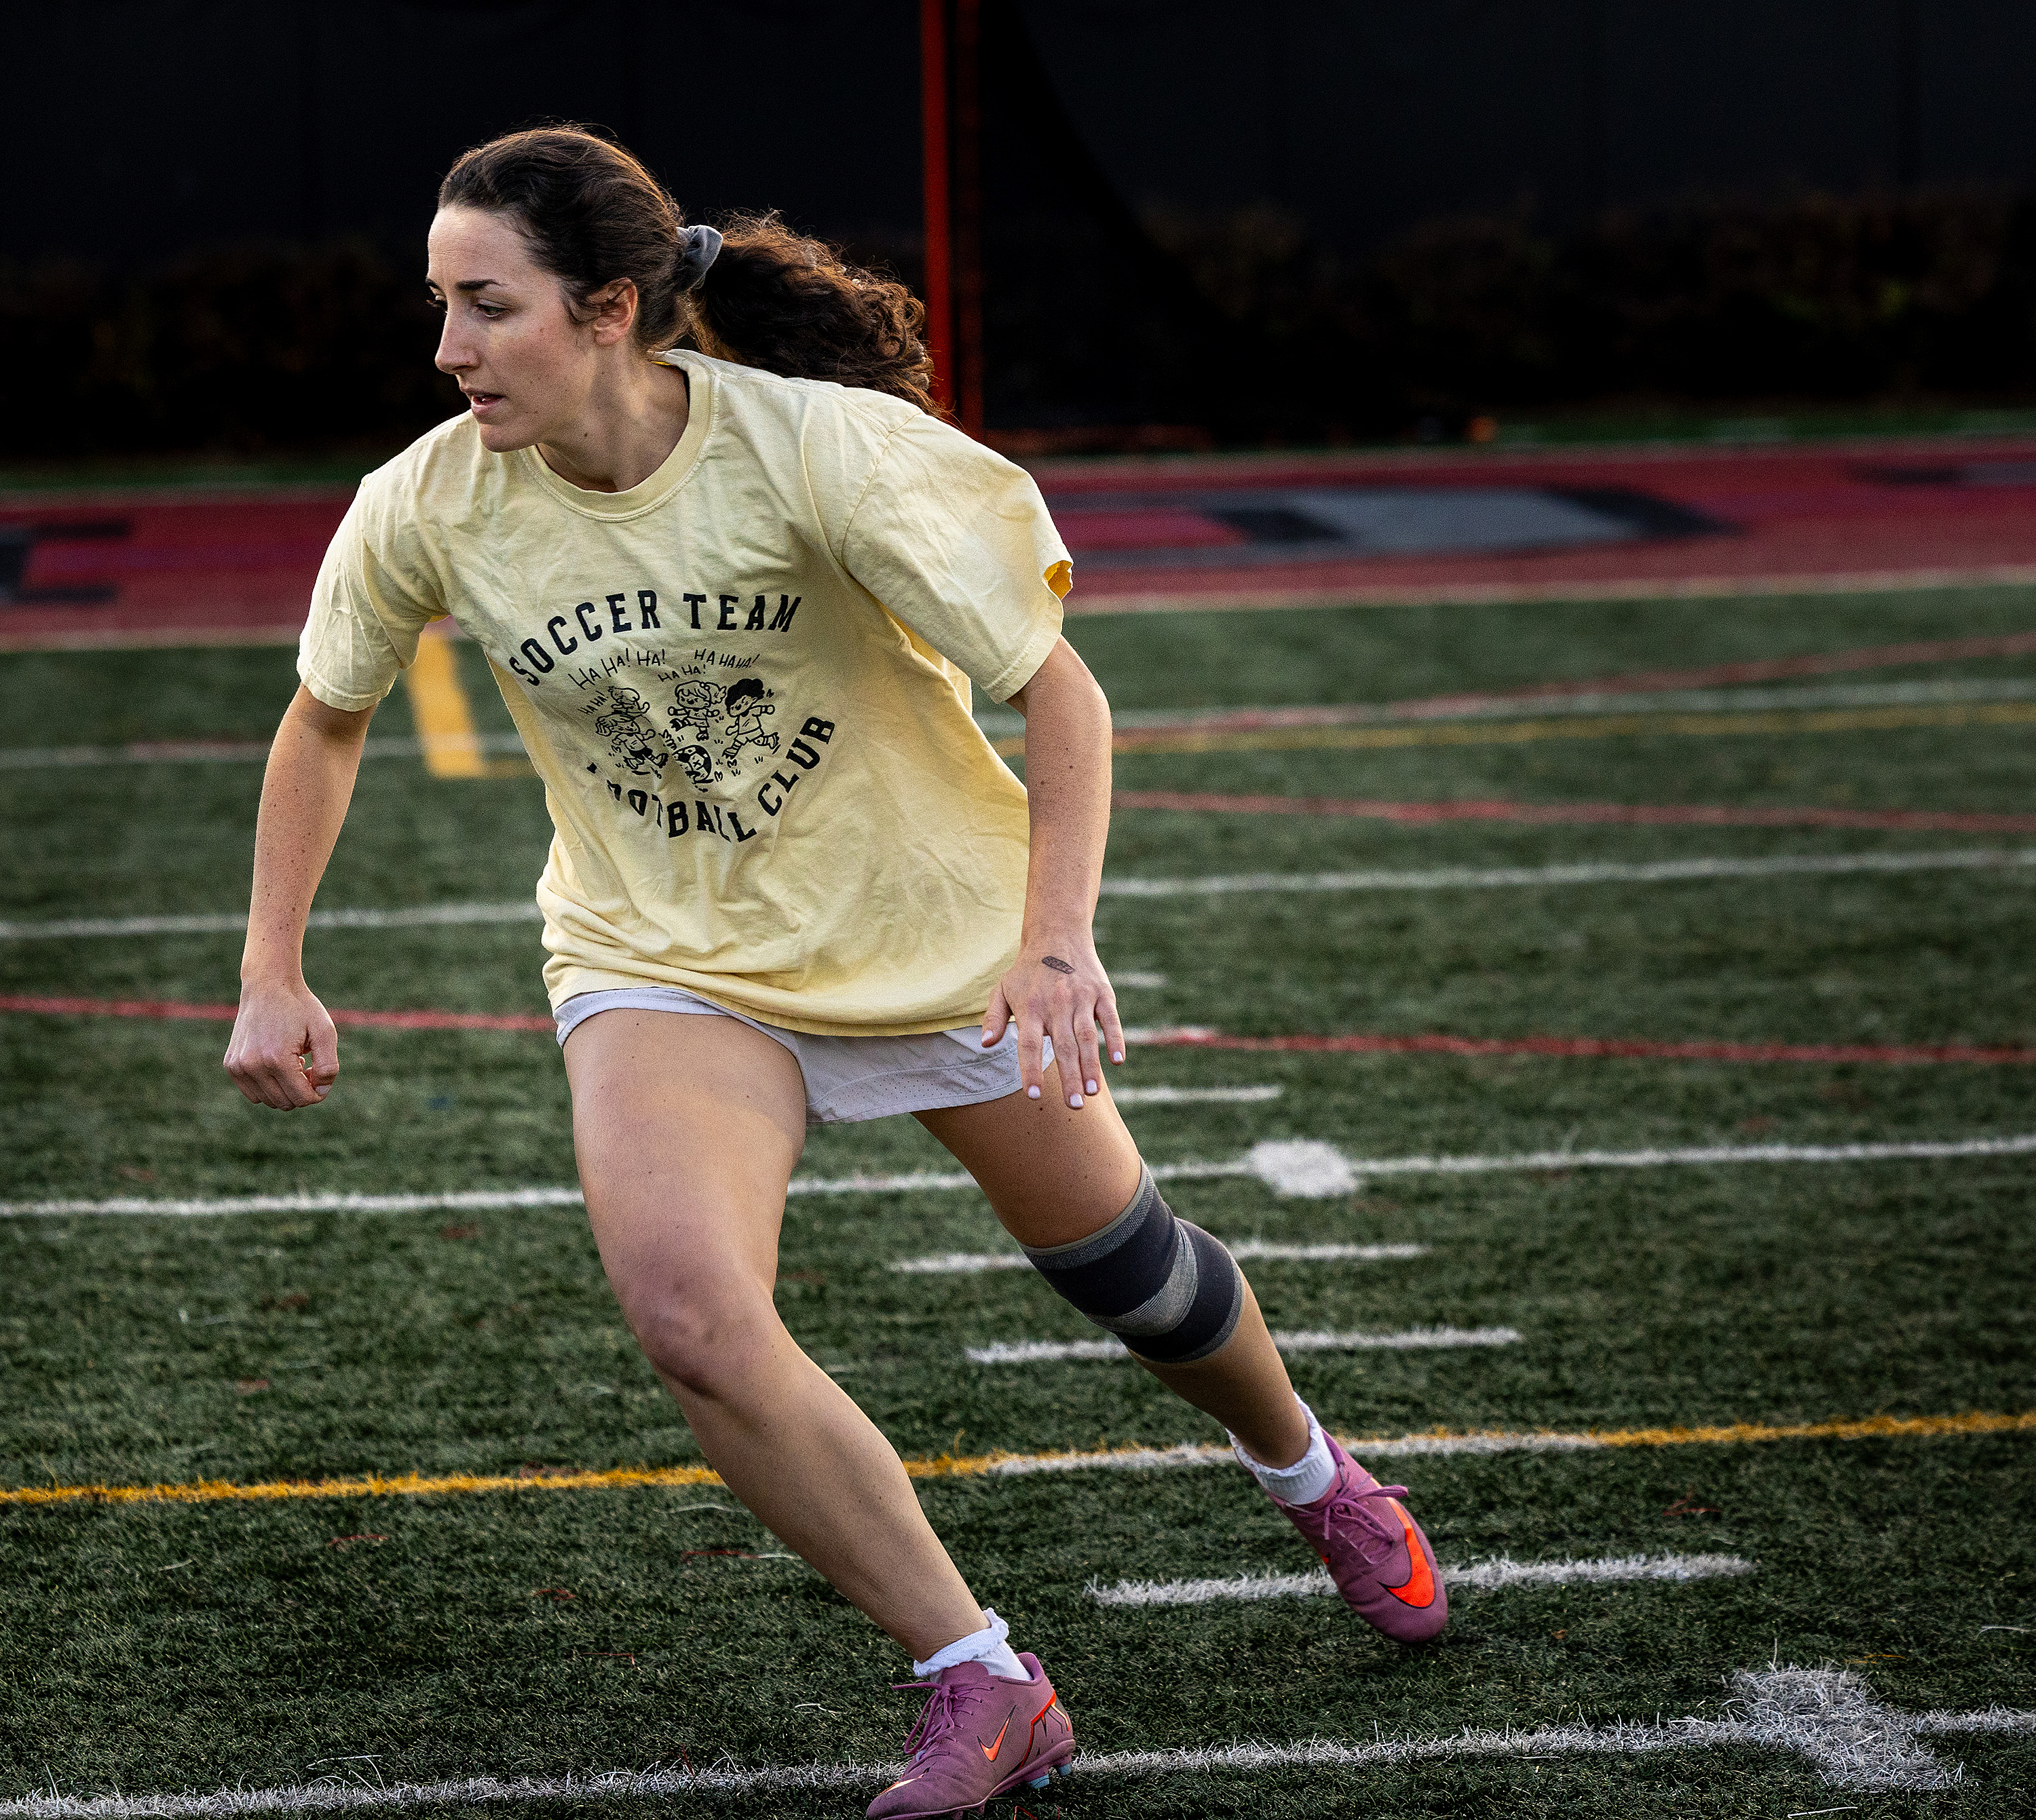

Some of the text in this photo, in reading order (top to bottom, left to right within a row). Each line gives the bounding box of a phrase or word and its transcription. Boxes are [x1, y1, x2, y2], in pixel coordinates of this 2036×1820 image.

[509, 590, 802, 686] SOCCER TEAM
[567, 647, 666, 690] HA HA! HA!
[586, 717, 836, 843] OTBALL CLUB
